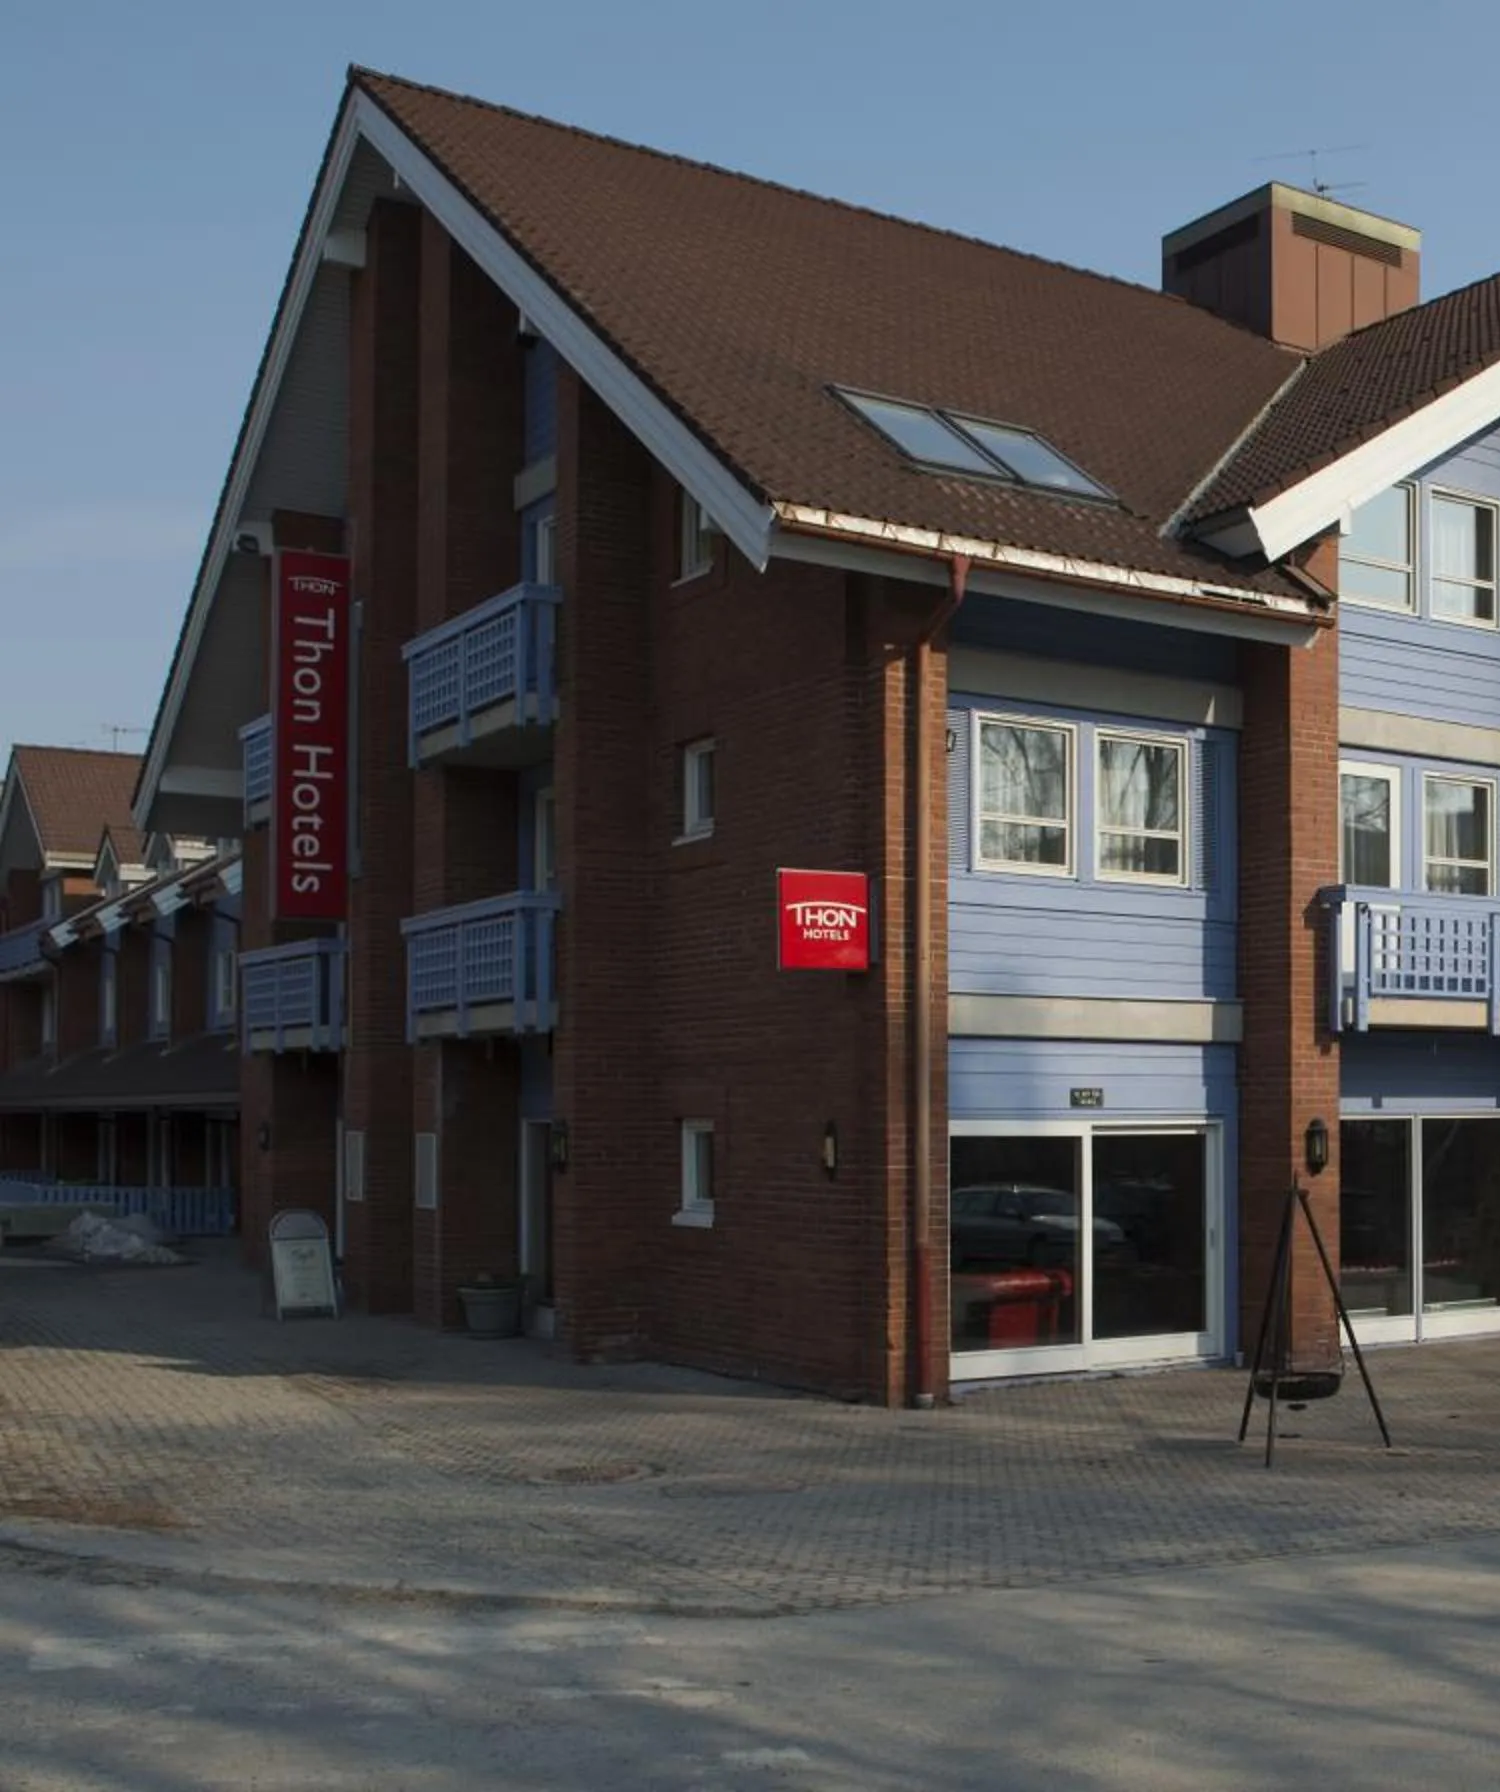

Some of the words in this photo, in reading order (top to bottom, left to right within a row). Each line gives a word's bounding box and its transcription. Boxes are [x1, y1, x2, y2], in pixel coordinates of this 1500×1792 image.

[288, 576, 343, 595] THON
[293, 608, 334, 721] Thon
[292, 745, 334, 893] Hotels
[786, 901, 866, 928] THON
[803, 928, 850, 941] HOTELS
